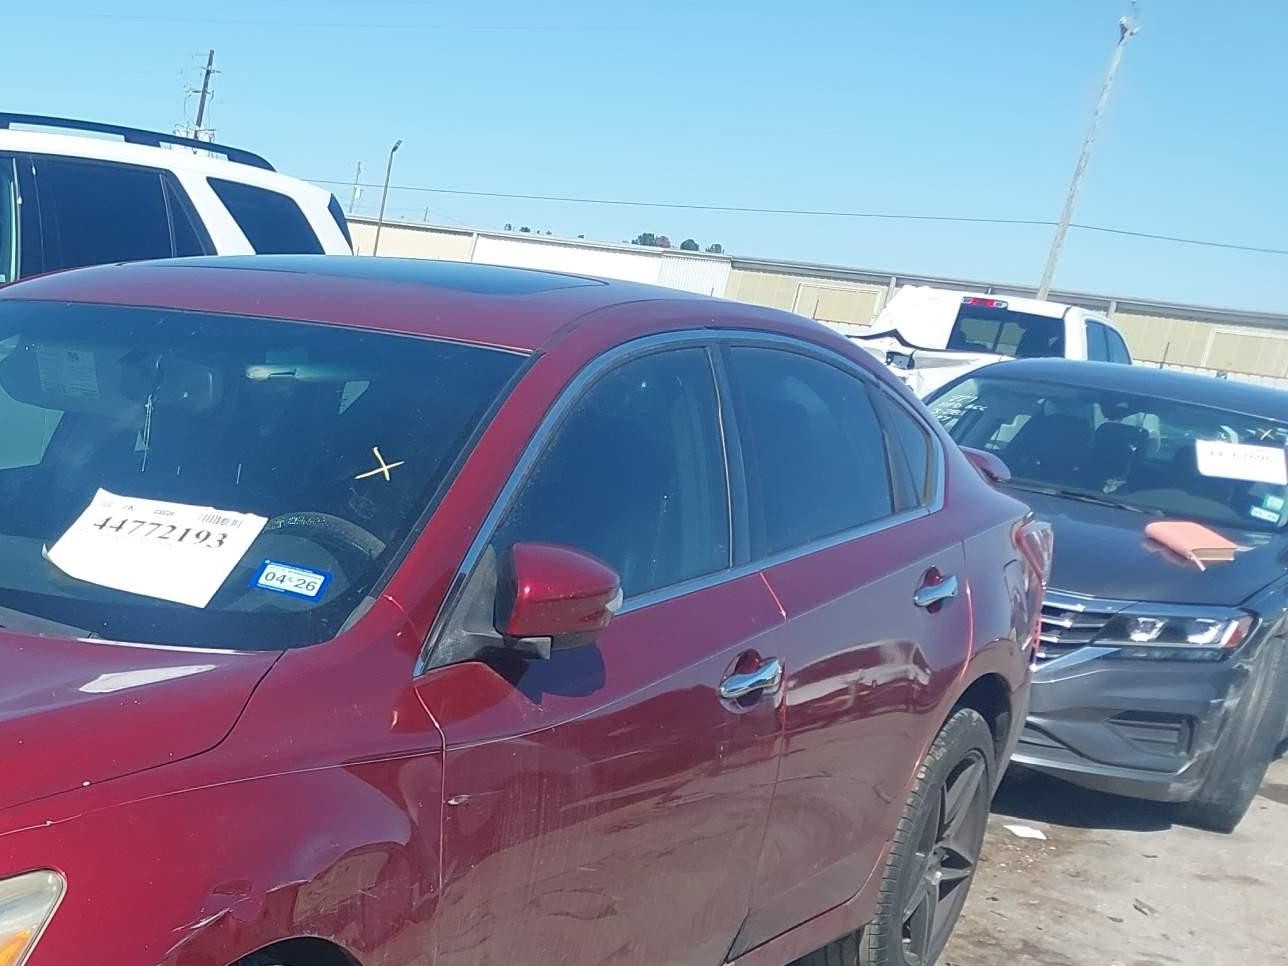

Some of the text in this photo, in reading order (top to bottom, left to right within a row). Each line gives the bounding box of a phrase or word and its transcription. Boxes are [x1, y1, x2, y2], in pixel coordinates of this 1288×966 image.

[93, 516, 228, 549] 44772193
[264, 570, 287, 585] 04
[293, 578, 318, 592] 26
